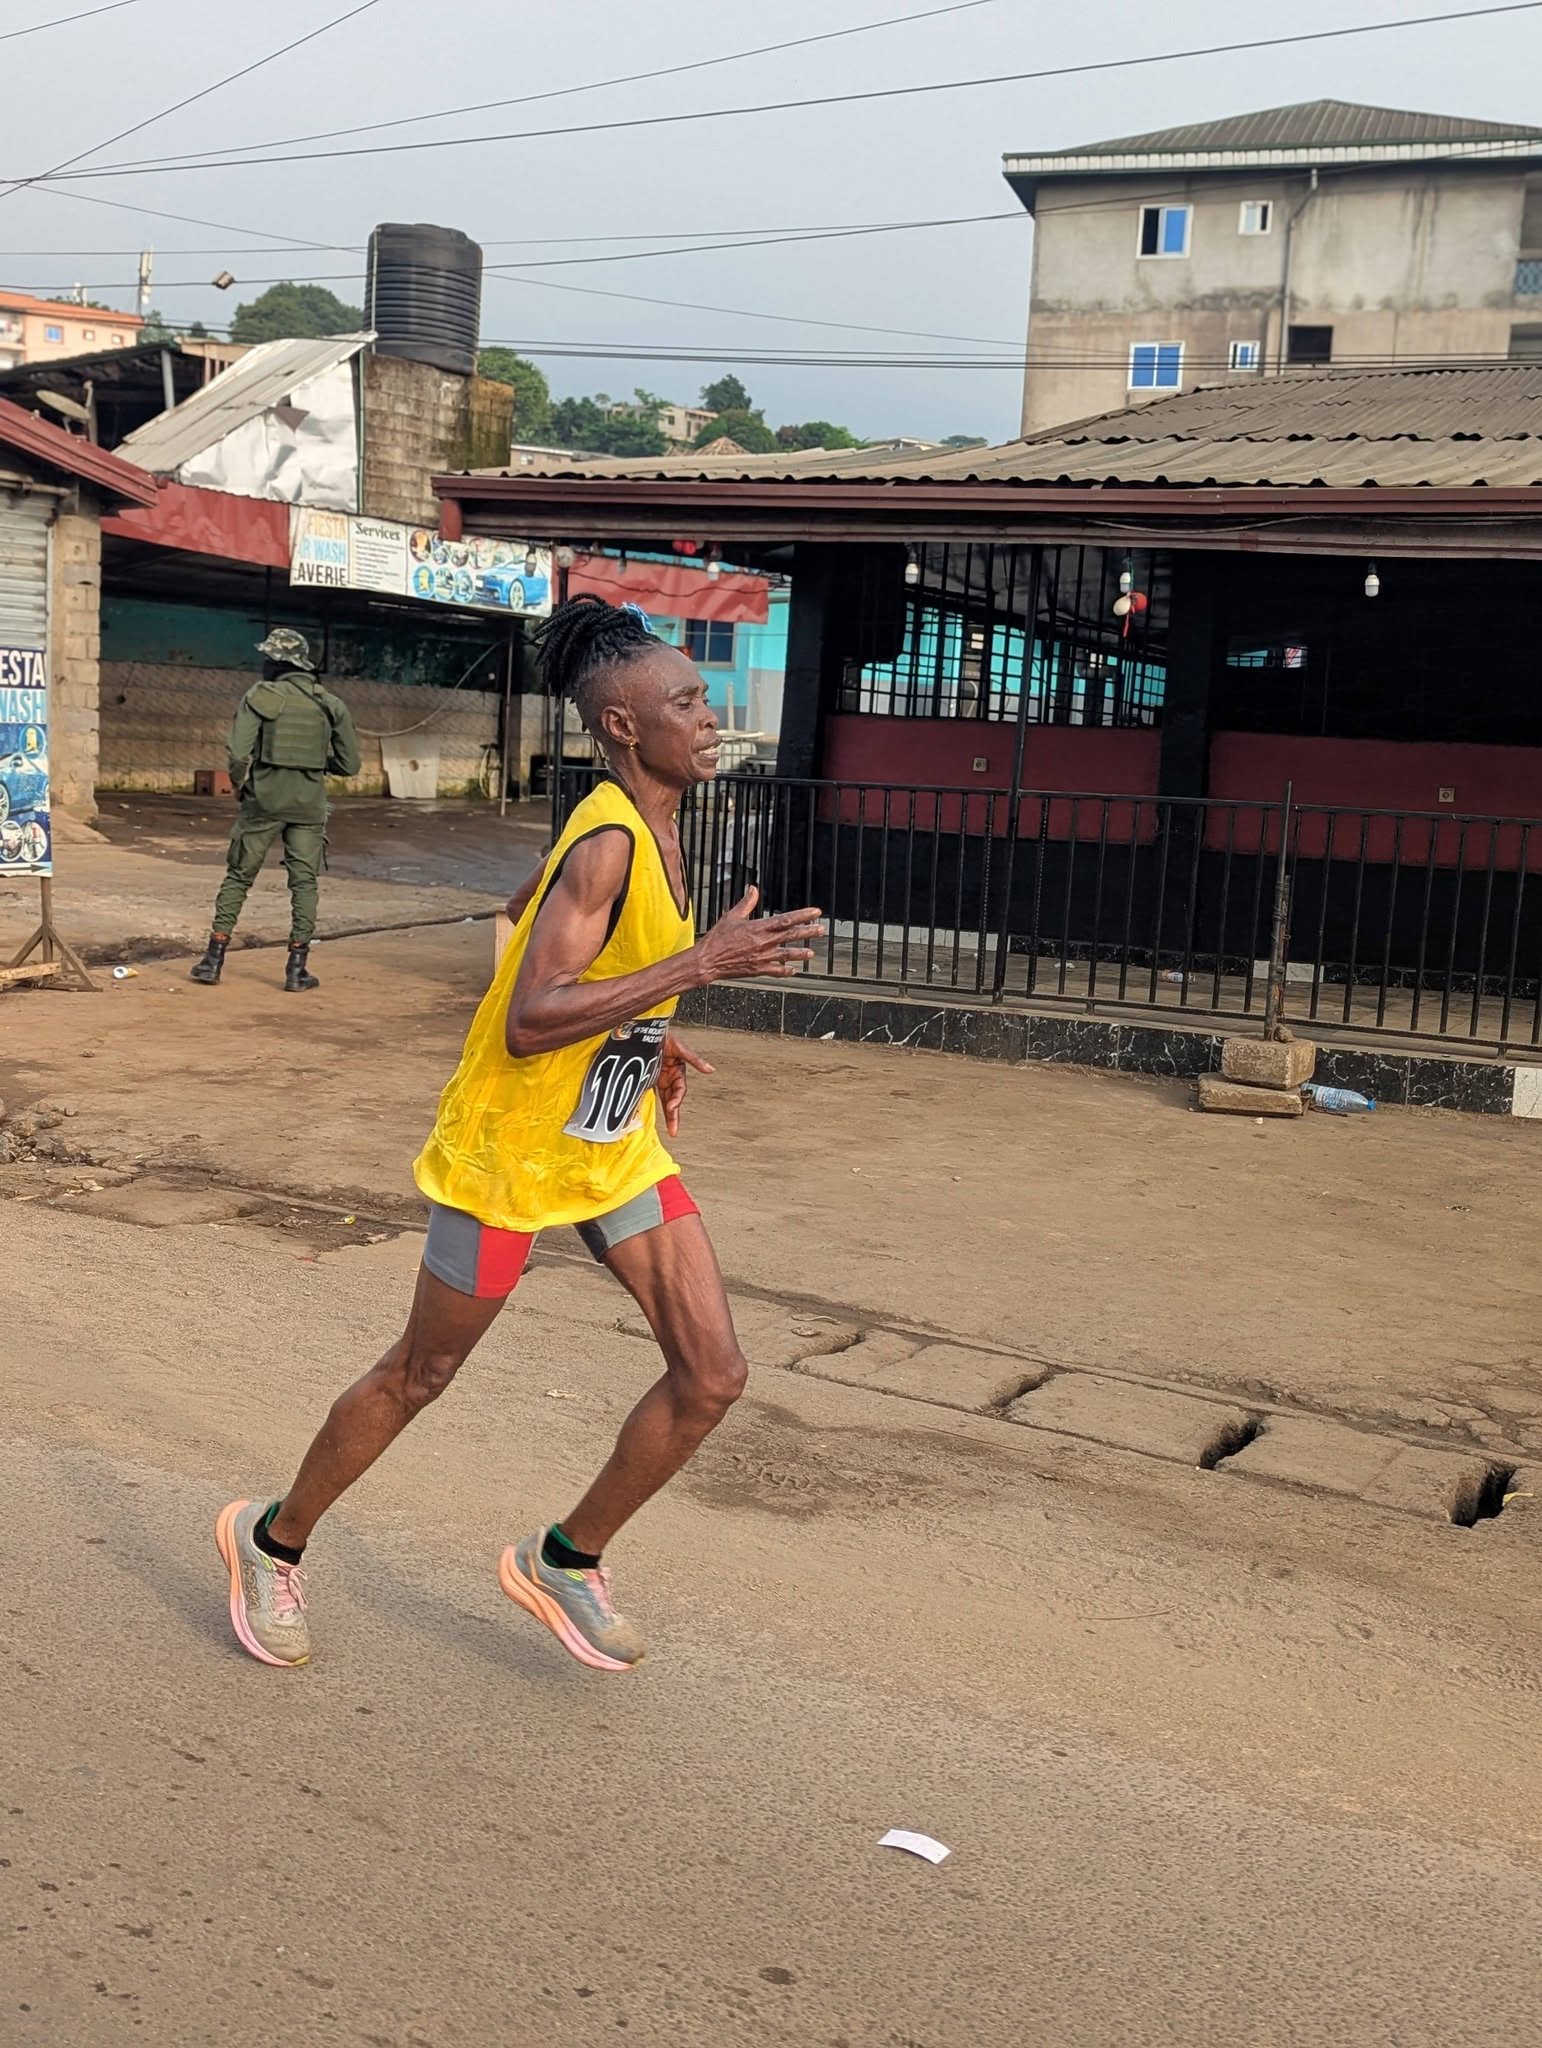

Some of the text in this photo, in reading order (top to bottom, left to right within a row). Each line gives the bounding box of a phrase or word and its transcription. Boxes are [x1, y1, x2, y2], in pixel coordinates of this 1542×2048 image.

[355, 521, 401, 541] Services
[314, 539, 347, 564] WASH
[294, 562, 347, 587] AVERIE
